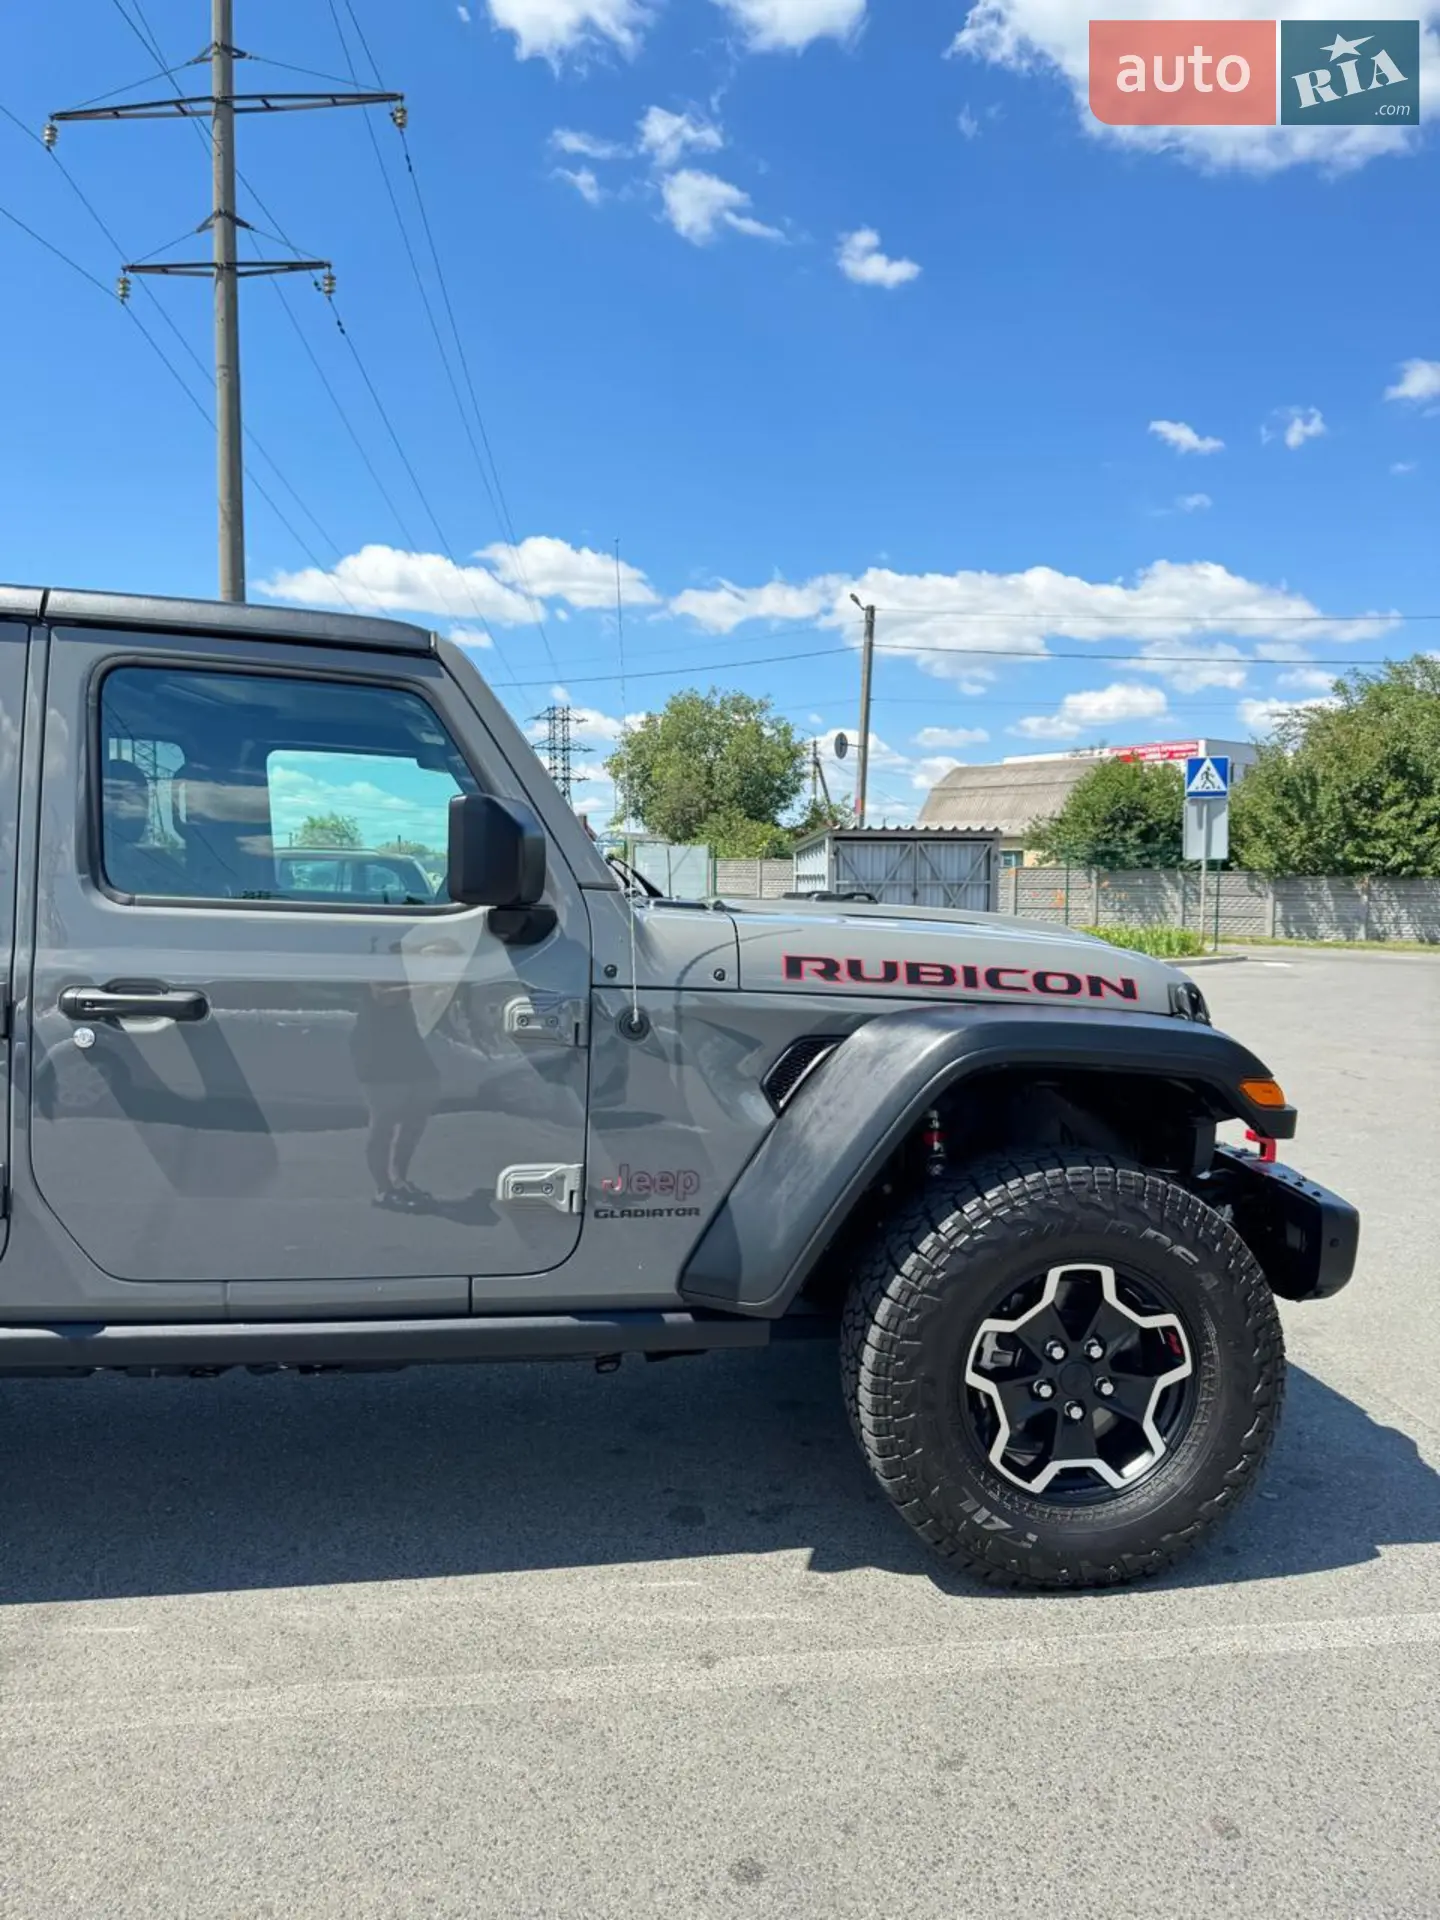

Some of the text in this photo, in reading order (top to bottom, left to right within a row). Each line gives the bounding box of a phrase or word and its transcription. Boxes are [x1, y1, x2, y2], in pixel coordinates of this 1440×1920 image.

[783, 955, 1139, 1001] RUBICON
[602, 1164, 700, 1201] Jeep
[594, 1207, 700, 1219] GLADIATOR
